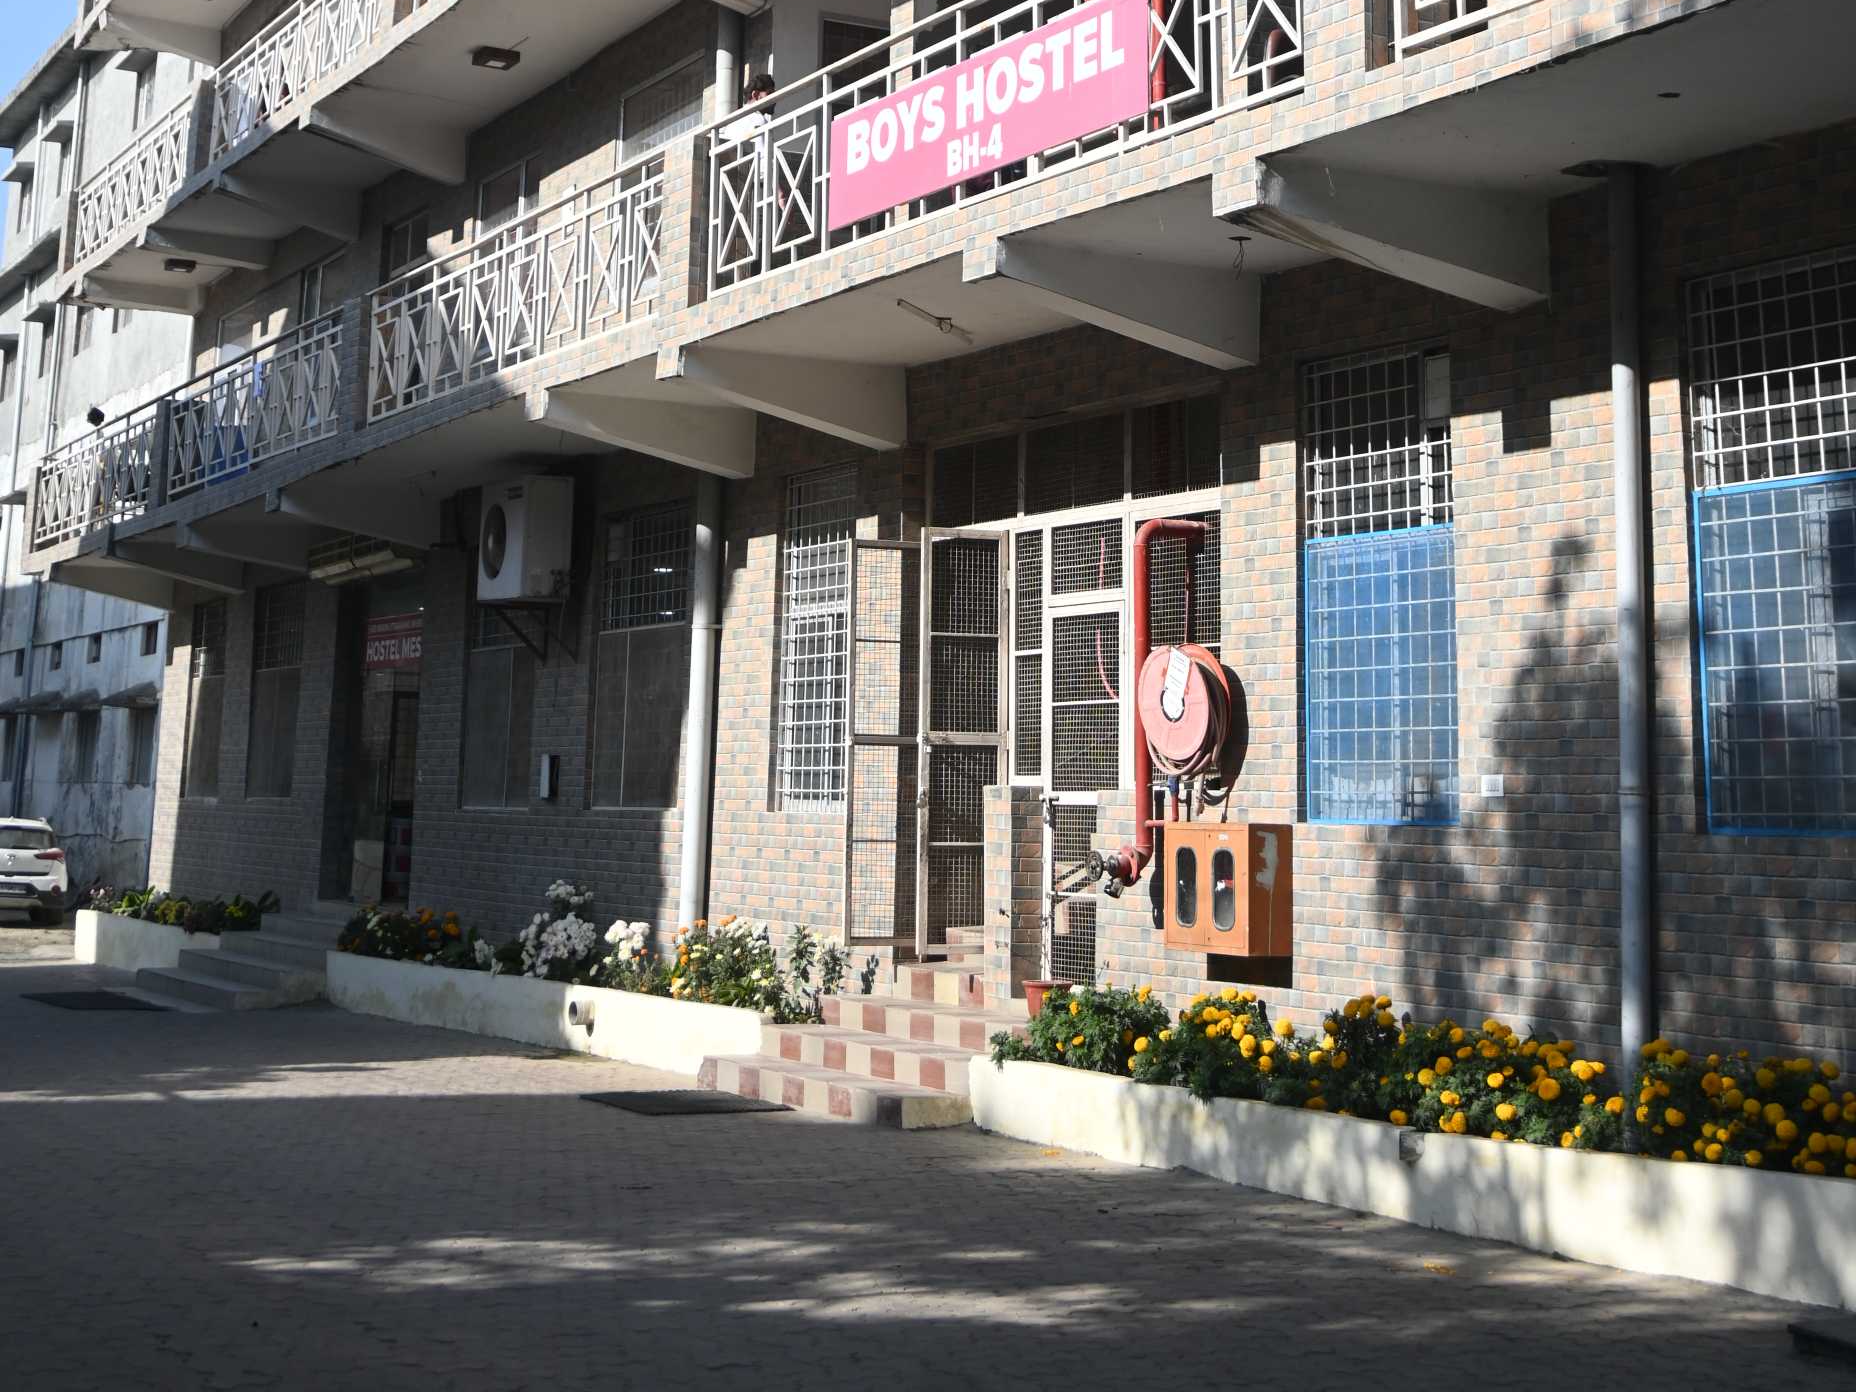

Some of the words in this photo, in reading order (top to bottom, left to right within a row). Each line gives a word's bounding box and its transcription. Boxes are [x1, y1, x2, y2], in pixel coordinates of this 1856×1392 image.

[846, 85, 945, 175] BOYS
[955, 10, 1125, 130] HOSTEL
[946, 123, 1003, 177] BH-4
[367, 639, 400, 662] HOSTEL
